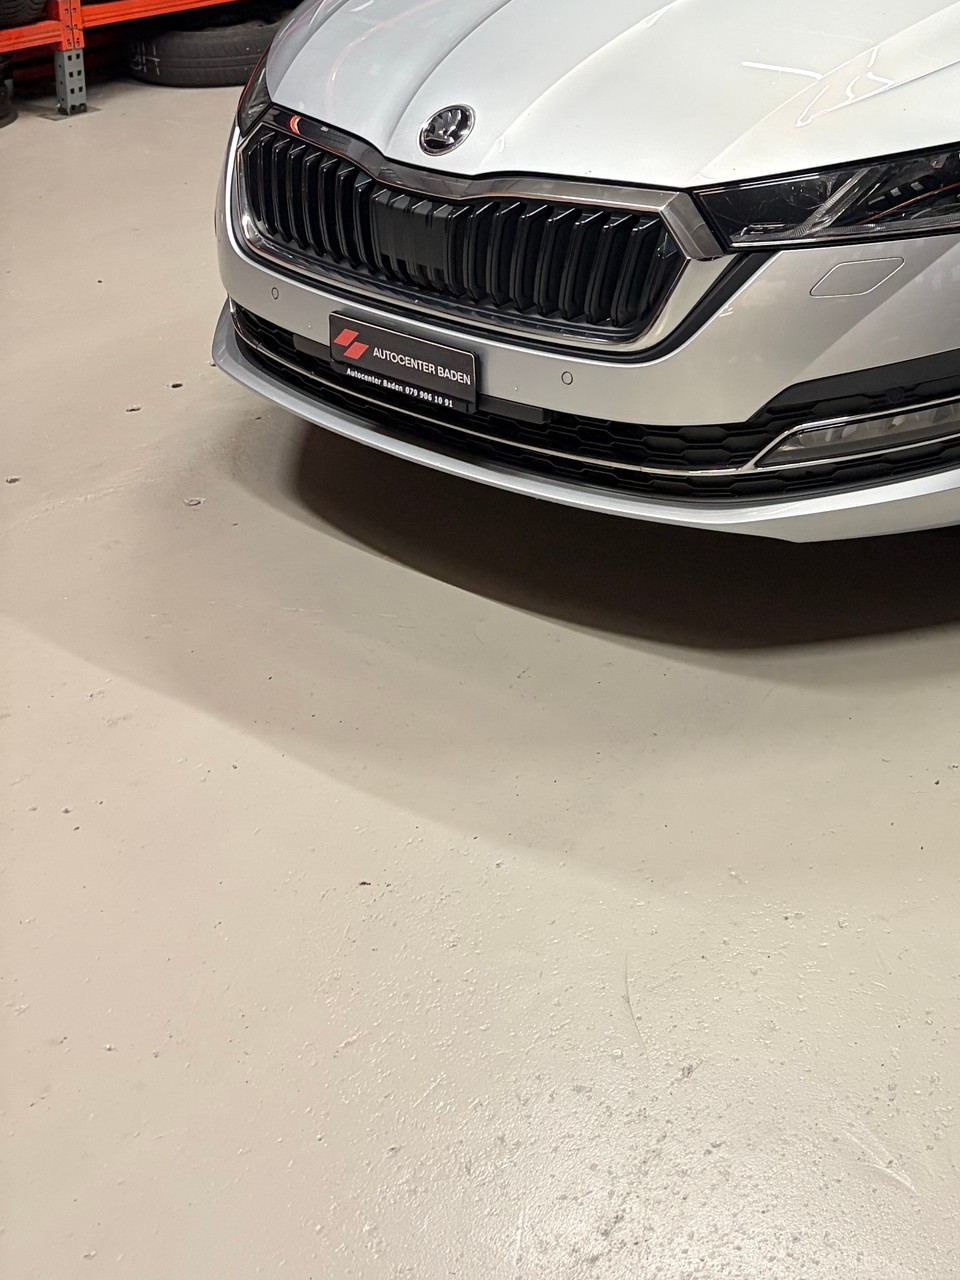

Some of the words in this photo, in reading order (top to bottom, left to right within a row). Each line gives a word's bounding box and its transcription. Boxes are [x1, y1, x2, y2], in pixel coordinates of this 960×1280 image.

[373, 347, 435, 374] AUTOCENTER
[437, 366, 471, 385] BADEN
[346, 368, 381, 385] Autocenter
[383, 379, 403, 392] Baden
[405, 386, 418, 397] 079
[419, 390, 433, 402] 906
[434, 395, 443, 405] 10
[444, 397, 454, 408] 91
